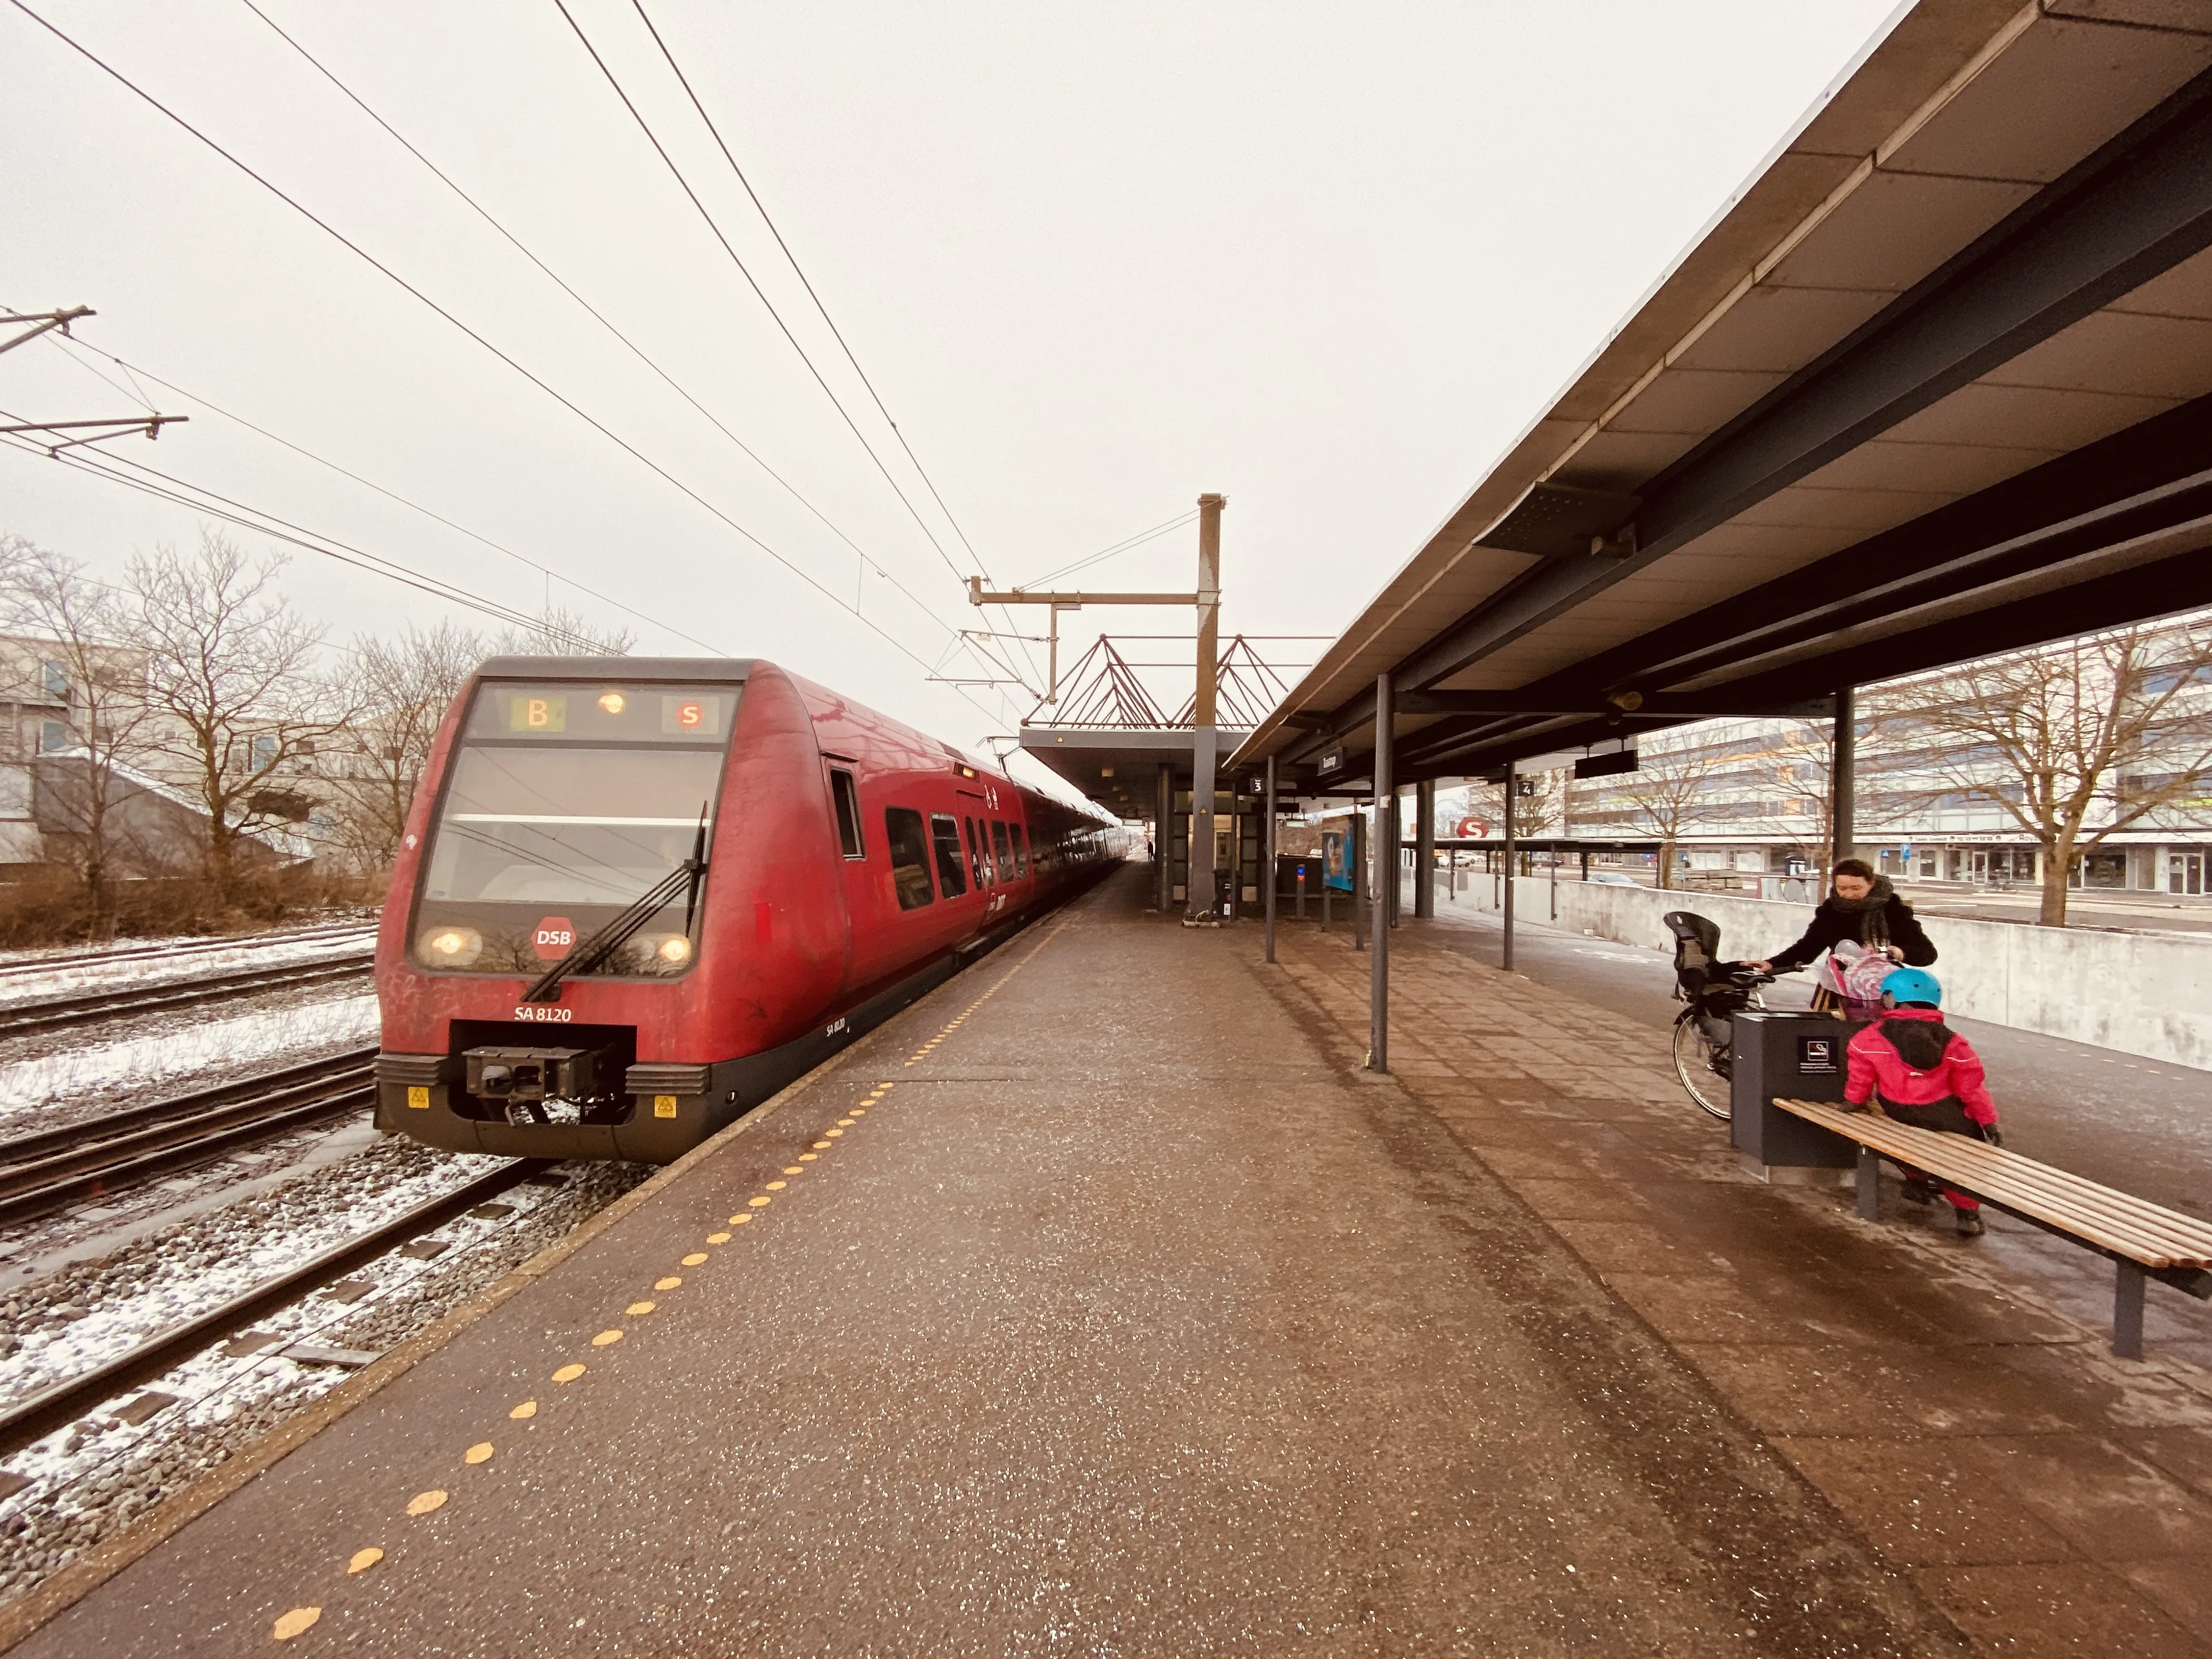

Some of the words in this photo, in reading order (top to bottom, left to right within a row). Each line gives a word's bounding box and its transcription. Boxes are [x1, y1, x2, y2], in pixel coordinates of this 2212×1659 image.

[528, 699, 548, 726] B
[682, 706, 699, 724] S
[1255, 782, 1261, 791] 3
[1465, 821, 1483, 838] S
[537, 930, 571, 945] DSB
[514, 1007, 534, 1020] SA
[535, 1008, 572, 1022] 8120
